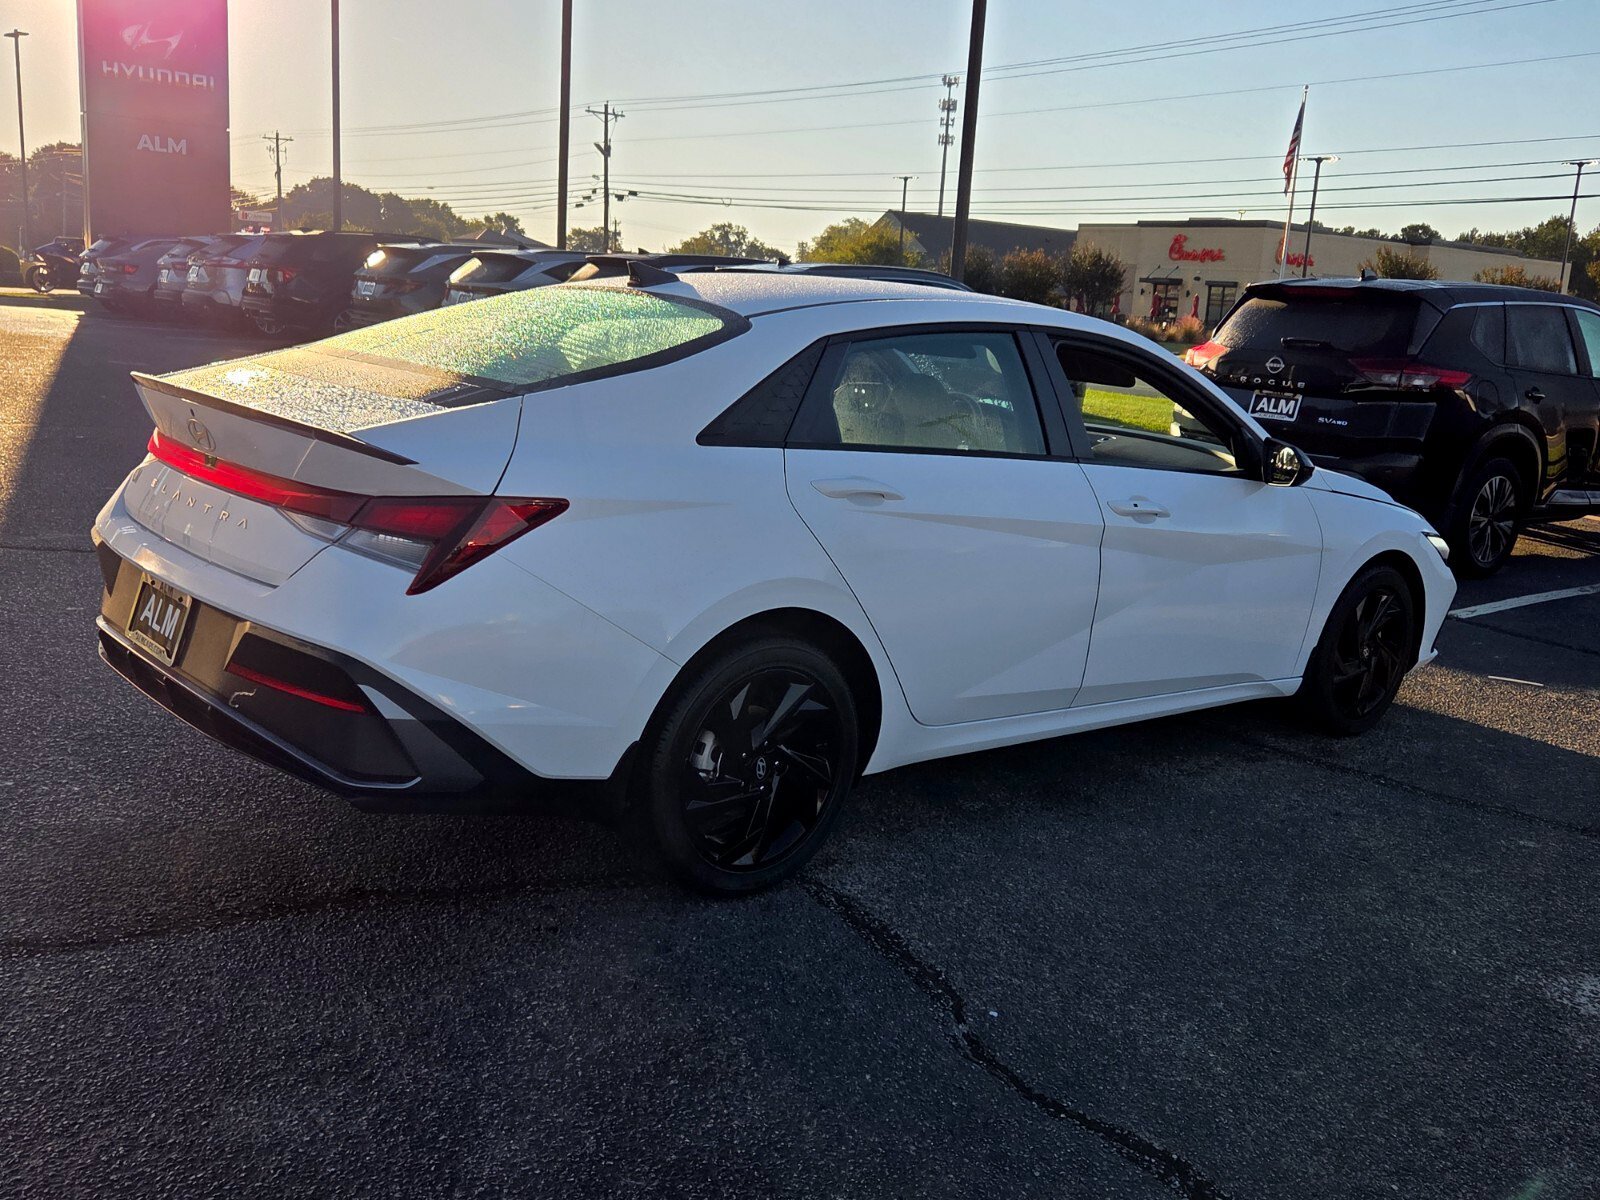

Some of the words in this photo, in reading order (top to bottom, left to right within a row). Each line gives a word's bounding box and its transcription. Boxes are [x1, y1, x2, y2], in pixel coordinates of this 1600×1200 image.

[102, 60, 215, 89] HYUNDAI
[137, 134, 188, 155] ALM
[1240, 376, 1305, 388] ROGUE
[1256, 397, 1296, 415] ALM
[150, 478, 247, 529] ELANTRA
[140, 593, 181, 640] ALM
